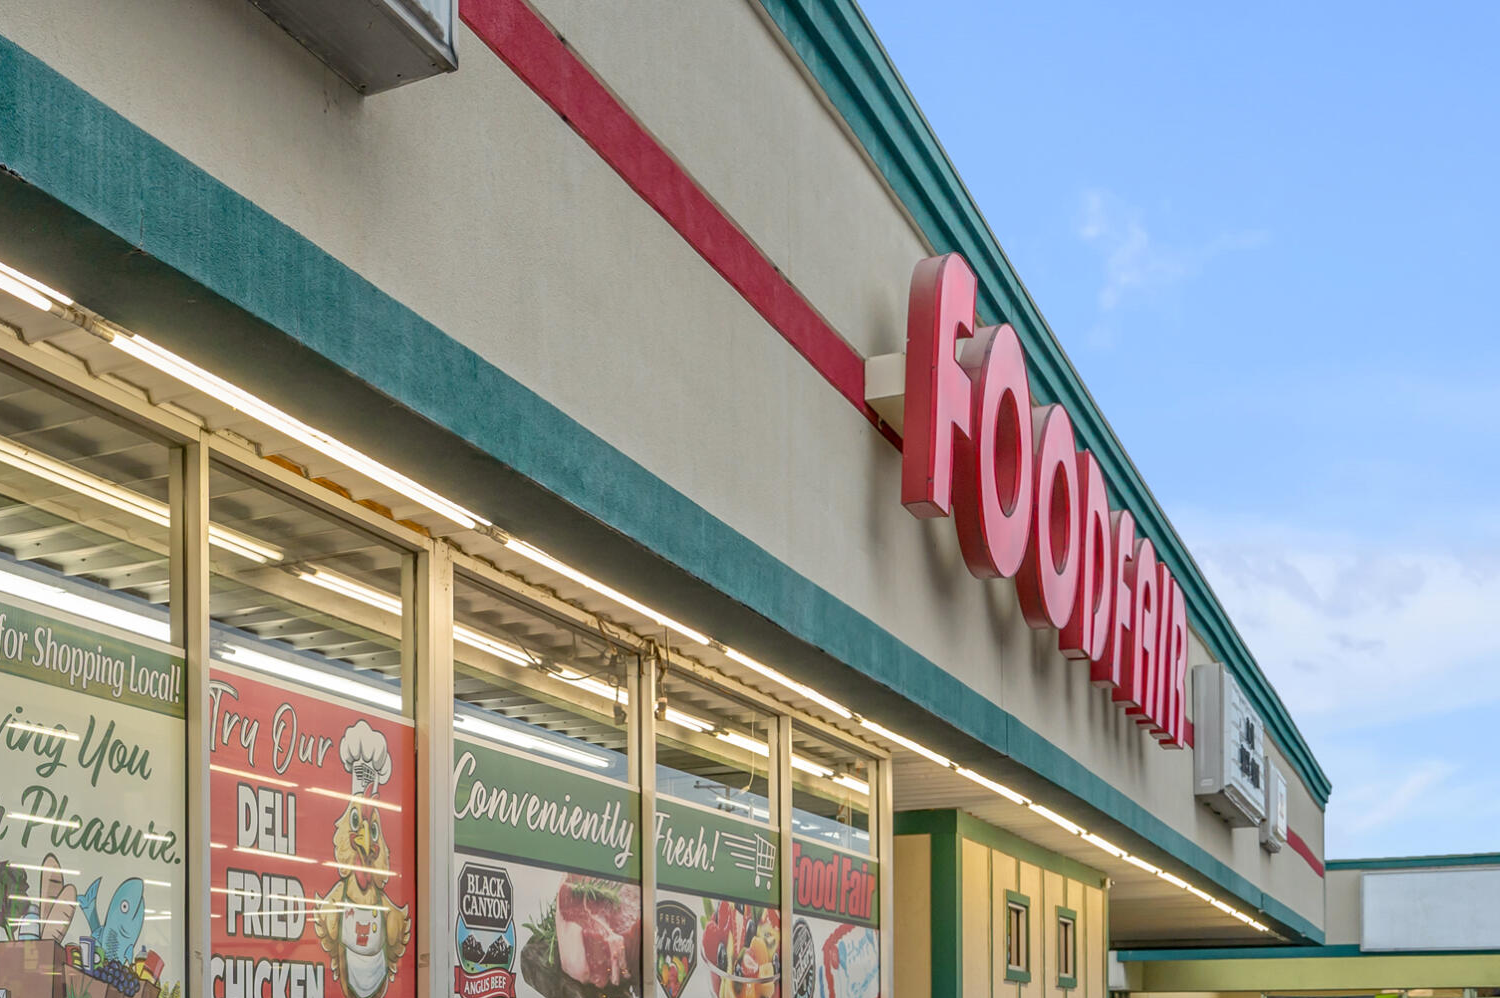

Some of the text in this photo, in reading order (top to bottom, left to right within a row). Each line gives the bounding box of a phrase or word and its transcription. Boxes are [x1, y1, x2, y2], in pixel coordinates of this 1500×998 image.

[31, 626, 124, 698] Shopping
[130, 655, 181, 703] Local!
[78, 715, 152, 787] You
[209, 679, 334, 775] Try Our
[21, 785, 181, 865] Pleasure.
[237, 781, 296, 856] DELI
[453, 751, 635, 869] Conveniently
[655, 811, 719, 872] Fresh!
[226, 867, 306, 942] FRIED
[462, 894, 508, 920] CANYON
[467, 873, 505, 899] BLACK
[792, 842, 876, 920] Food Fair
[660, 912, 686, 926] FRESH
[464, 975, 507, 994] ANGUS BEEF
